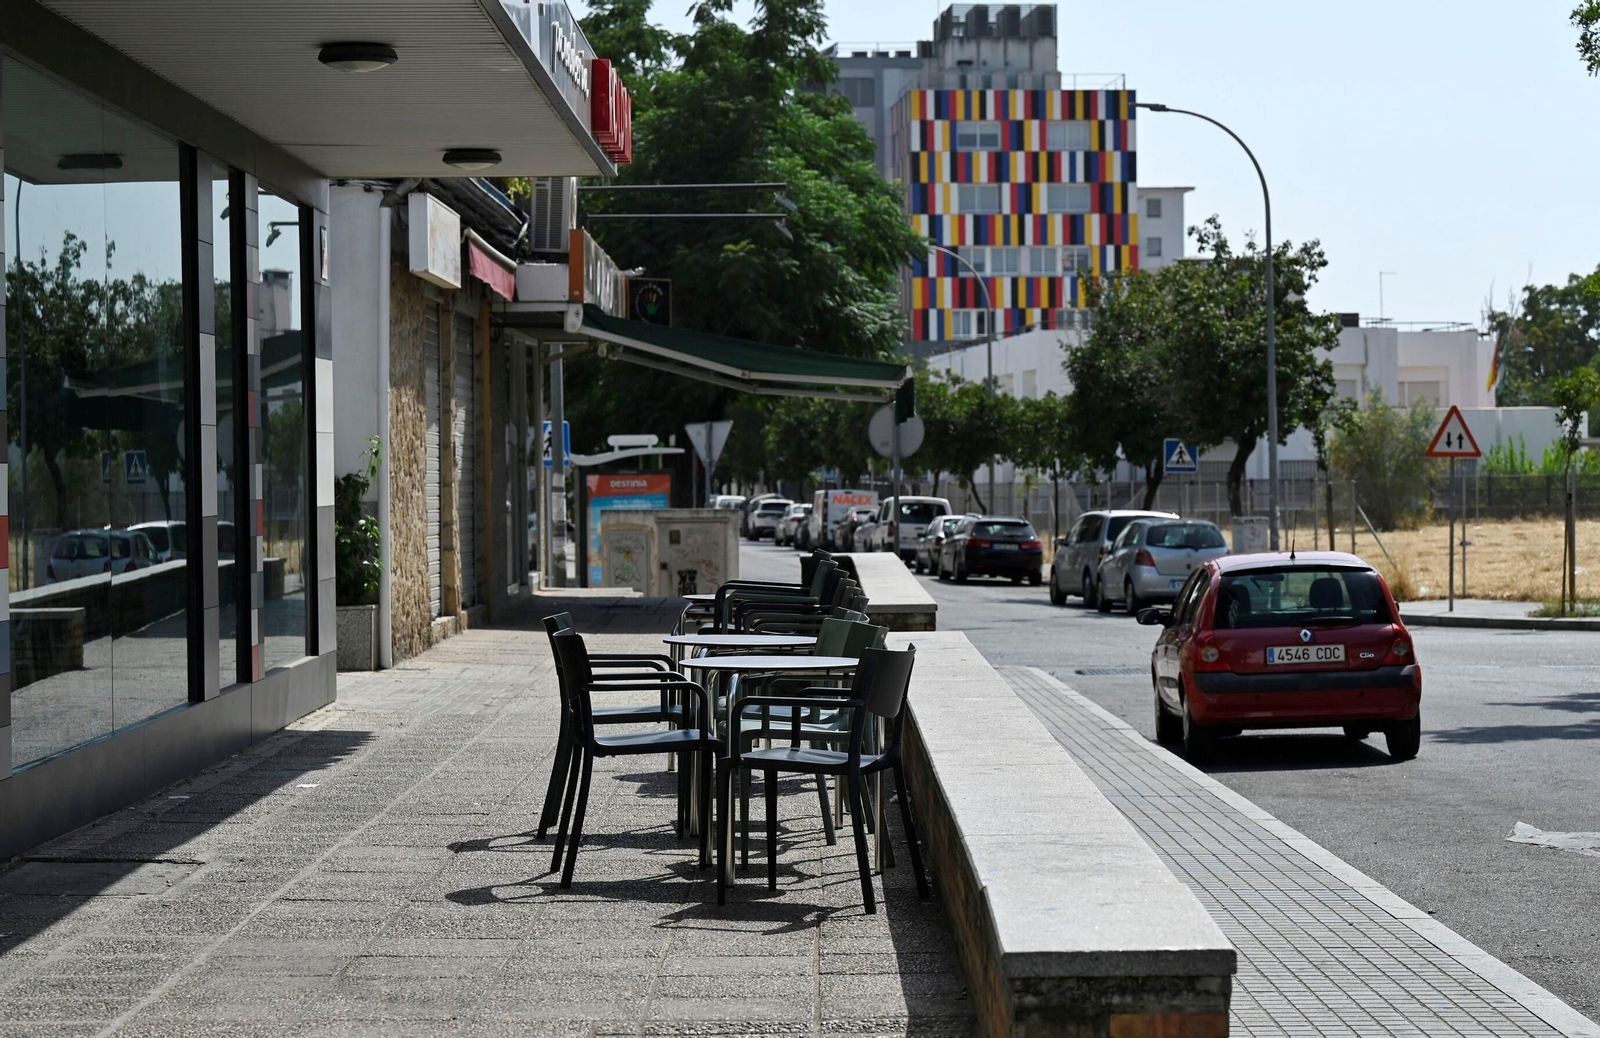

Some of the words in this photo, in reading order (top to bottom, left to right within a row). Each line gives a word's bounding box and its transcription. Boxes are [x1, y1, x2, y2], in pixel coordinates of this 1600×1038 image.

[832, 494, 873, 506] NACEX
[1277, 647, 1310, 662] 4546
[1316, 646, 1341, 660] CDC
[1359, 651, 1375, 659] Clio
